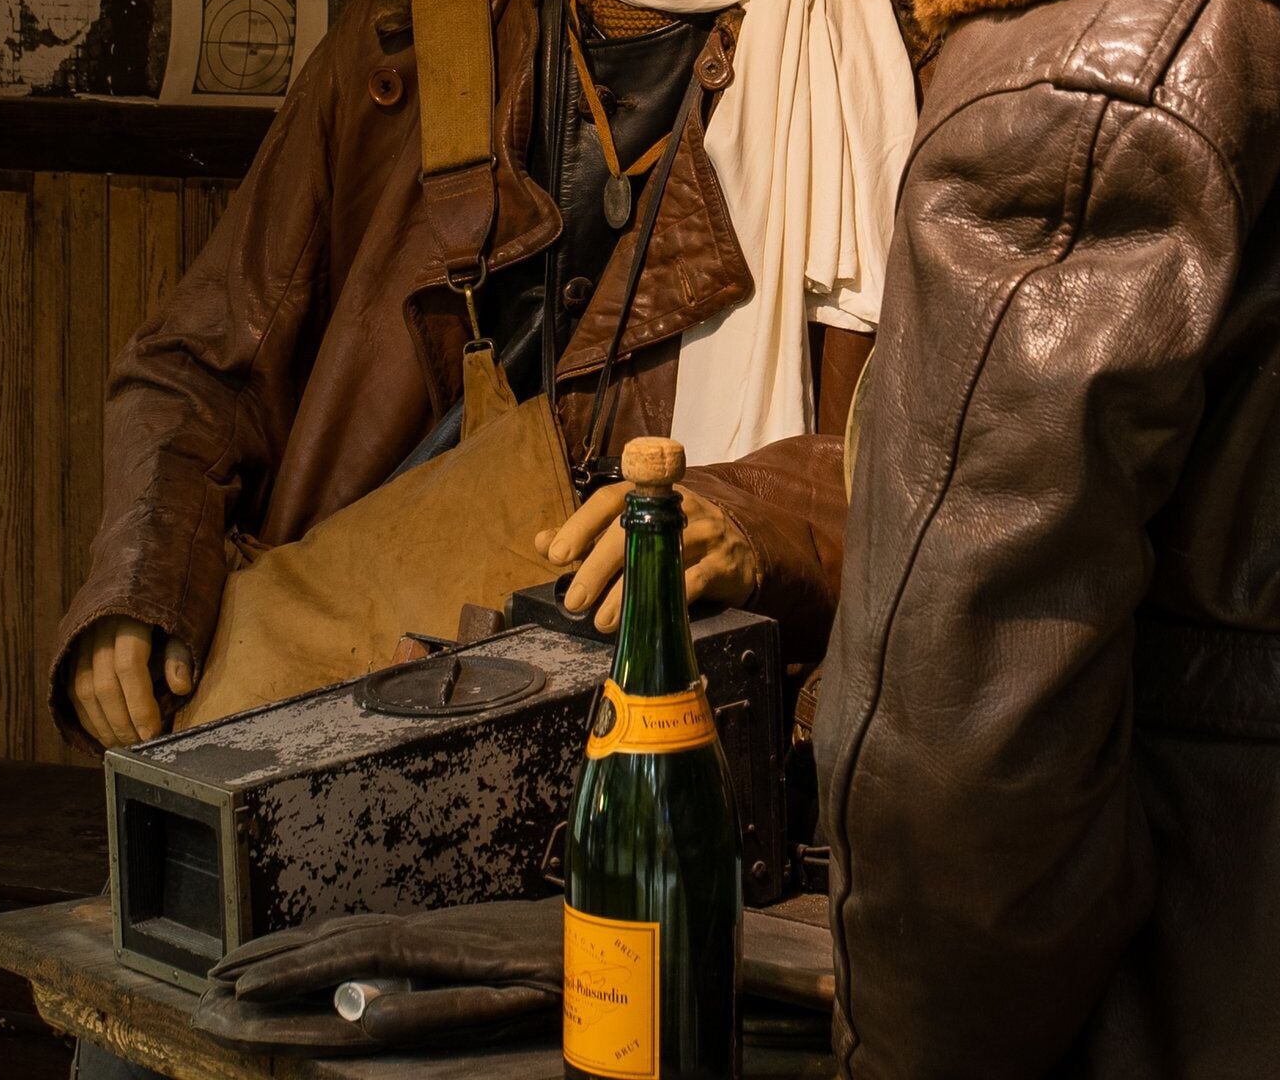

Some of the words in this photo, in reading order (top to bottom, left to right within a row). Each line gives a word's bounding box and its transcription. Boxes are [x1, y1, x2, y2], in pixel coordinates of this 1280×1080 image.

[641, 714, 680, 730] Veuve
[614, 938, 641, 963] BRUT
[614, 1038, 641, 1061] BRUT
